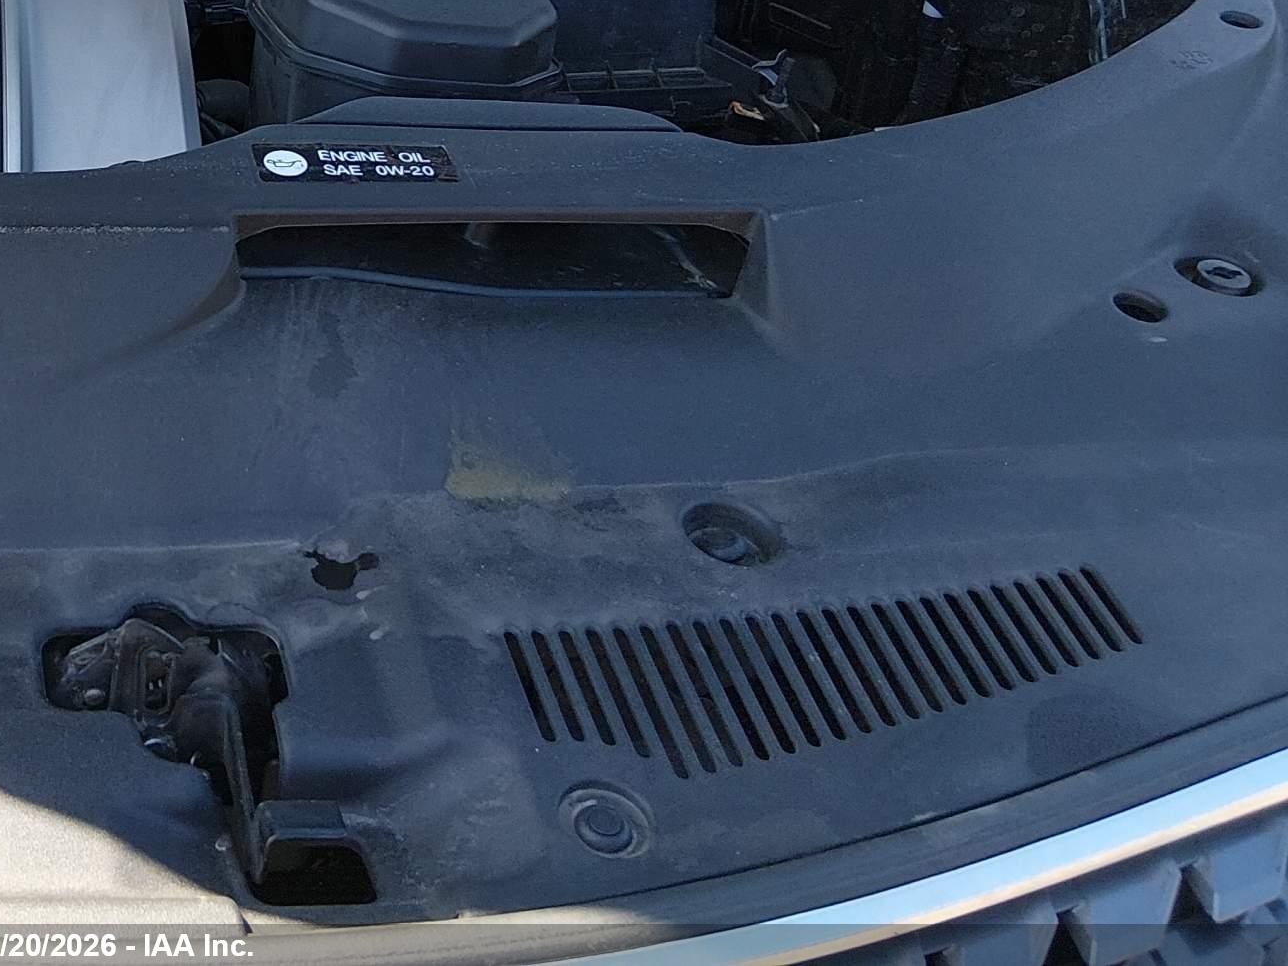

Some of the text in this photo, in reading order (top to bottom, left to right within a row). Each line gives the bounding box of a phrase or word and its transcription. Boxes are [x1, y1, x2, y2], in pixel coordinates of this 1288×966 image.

[316, 149, 432, 164] ENGINE OIL
[323, 164, 435, 177] SAE 0W-20
